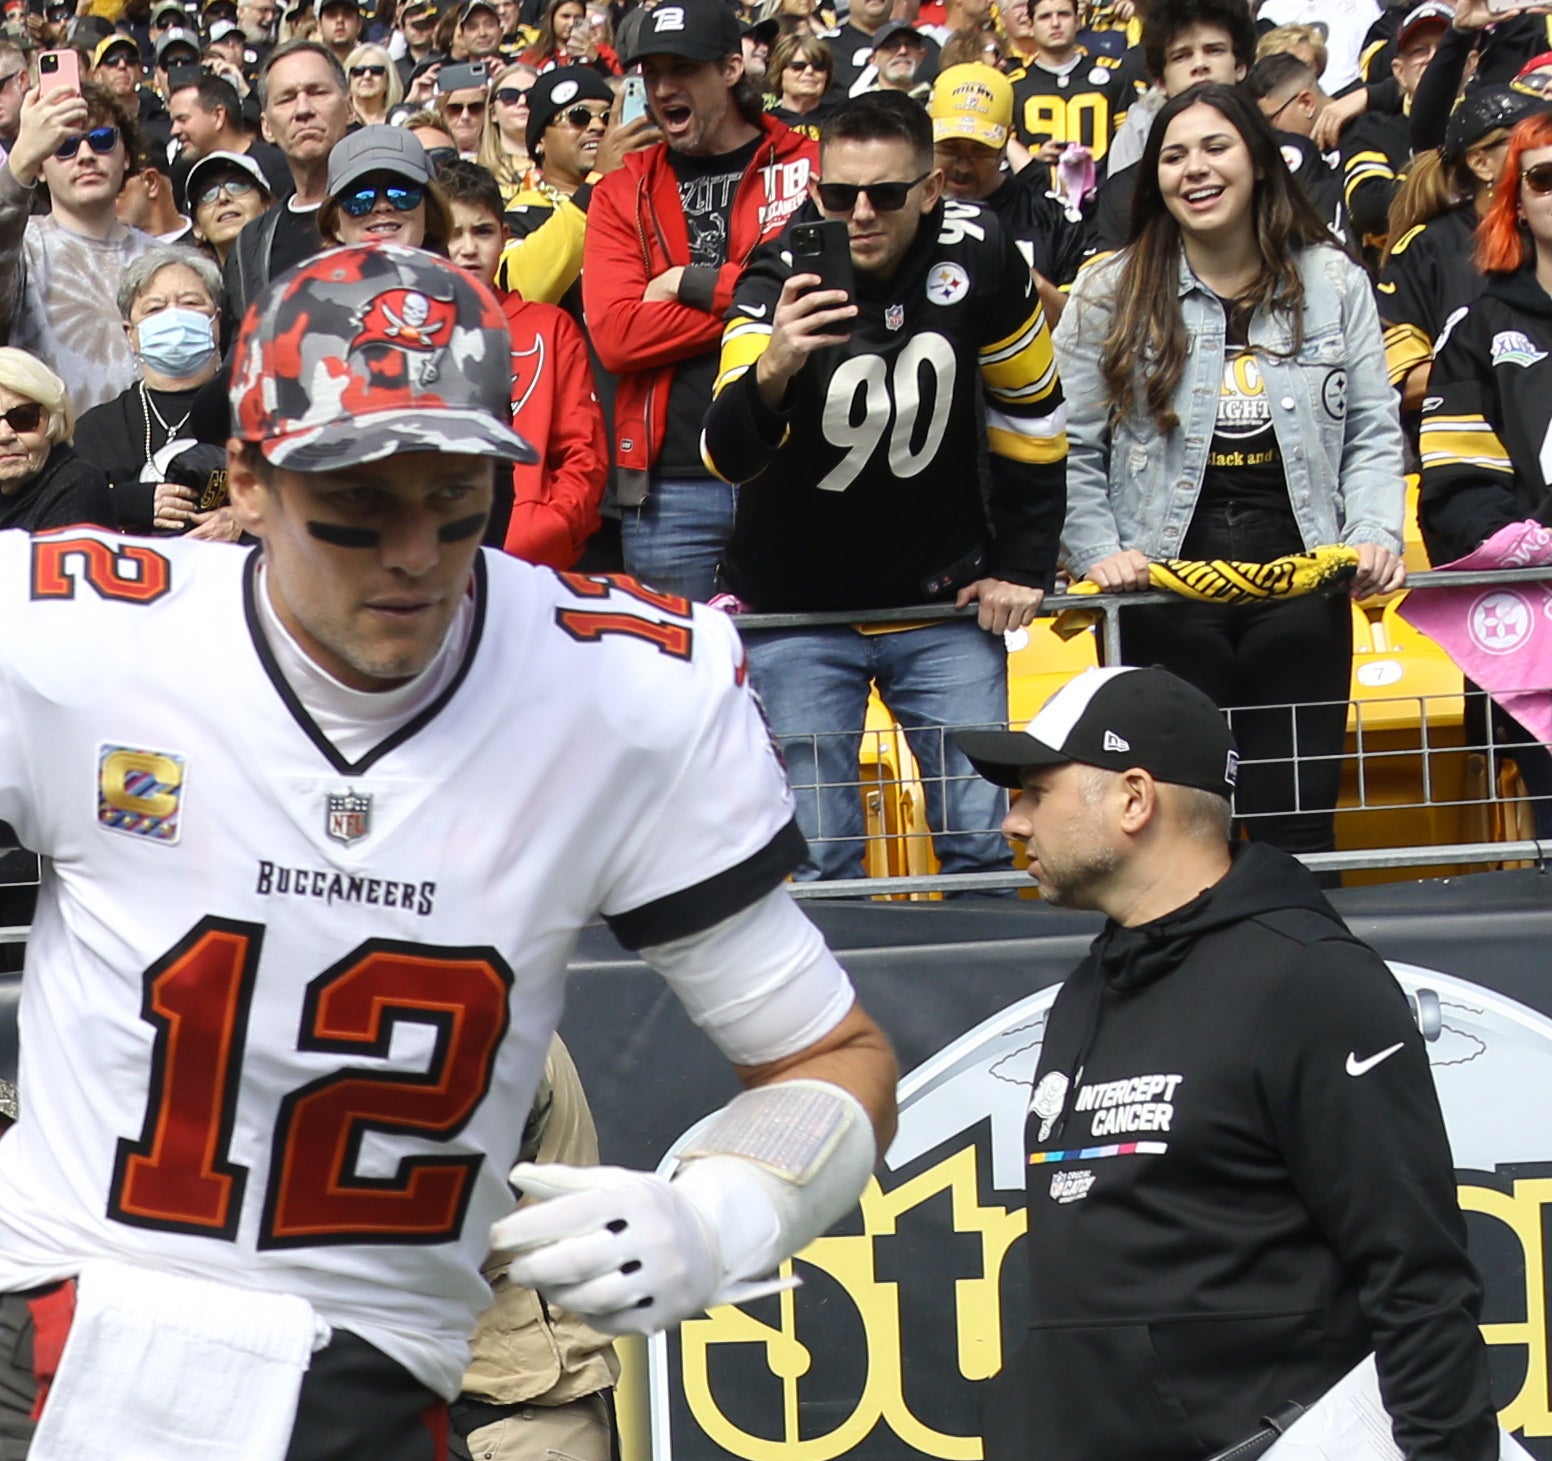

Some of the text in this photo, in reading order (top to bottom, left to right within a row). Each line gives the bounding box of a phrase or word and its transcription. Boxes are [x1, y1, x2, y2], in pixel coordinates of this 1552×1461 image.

[1024, 91, 1109, 162] 90
[817, 331, 958, 493] 90
[1217, 400, 1270, 420] IGHT
[30, 526, 172, 606] 2
[99, 750, 180, 818] C
[330, 811, 367, 838] NFL
[256, 859, 437, 917] BUCCANEERS
[106, 911, 515, 1249] 12
[1075, 1074, 1183, 1113] INTERCEPT
[1090, 1101, 1175, 1137] CANCER
